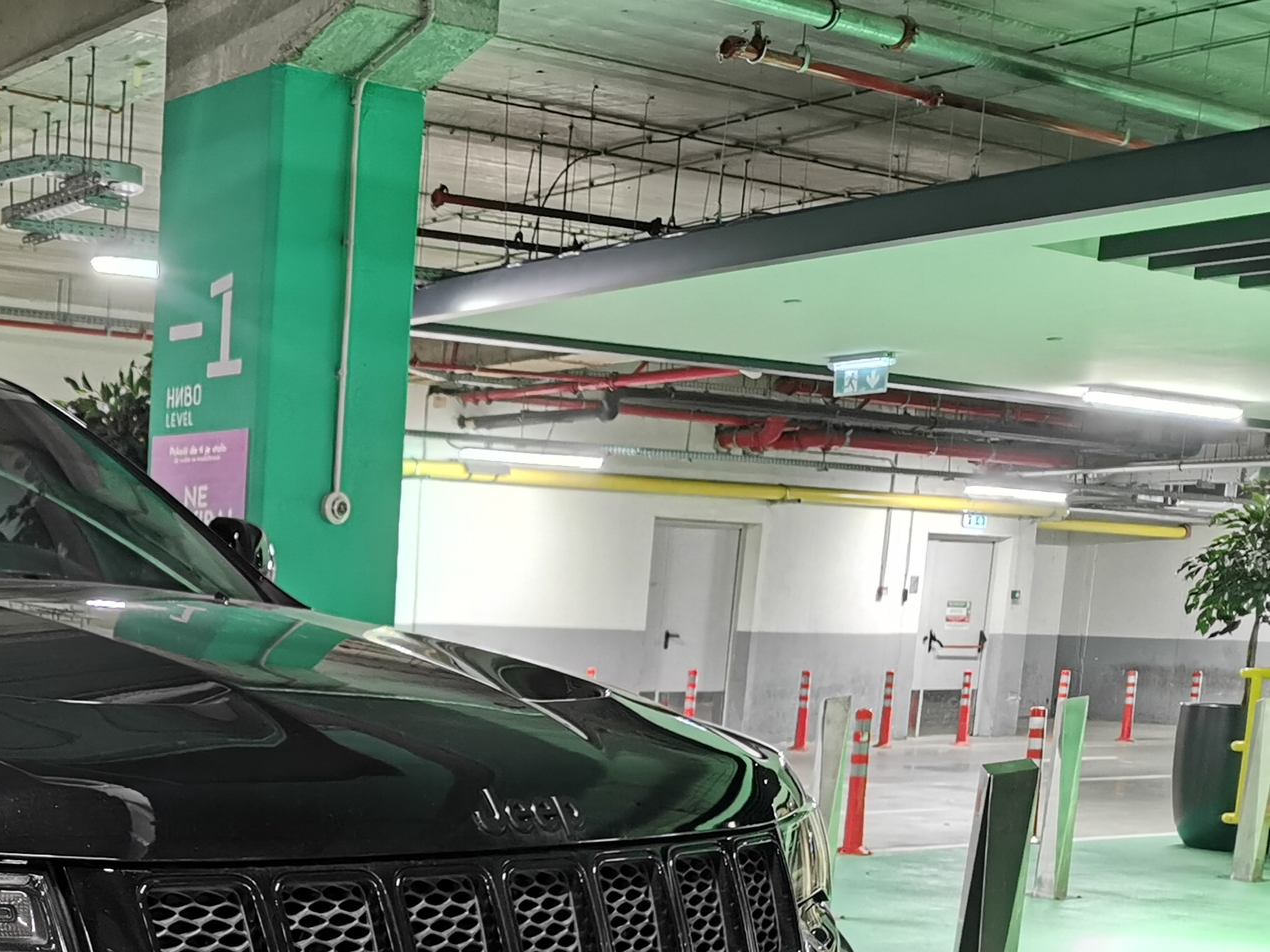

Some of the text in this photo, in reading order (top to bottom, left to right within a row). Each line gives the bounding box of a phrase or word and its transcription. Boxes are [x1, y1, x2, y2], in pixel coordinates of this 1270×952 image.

[169, 272, 243, 379] -1
[165, 383, 203, 410] НИВО
[165, 410, 194, 429] LEVEL
[184, 484, 208, 508] NE
[472, 788, 584, 841] Jeep
